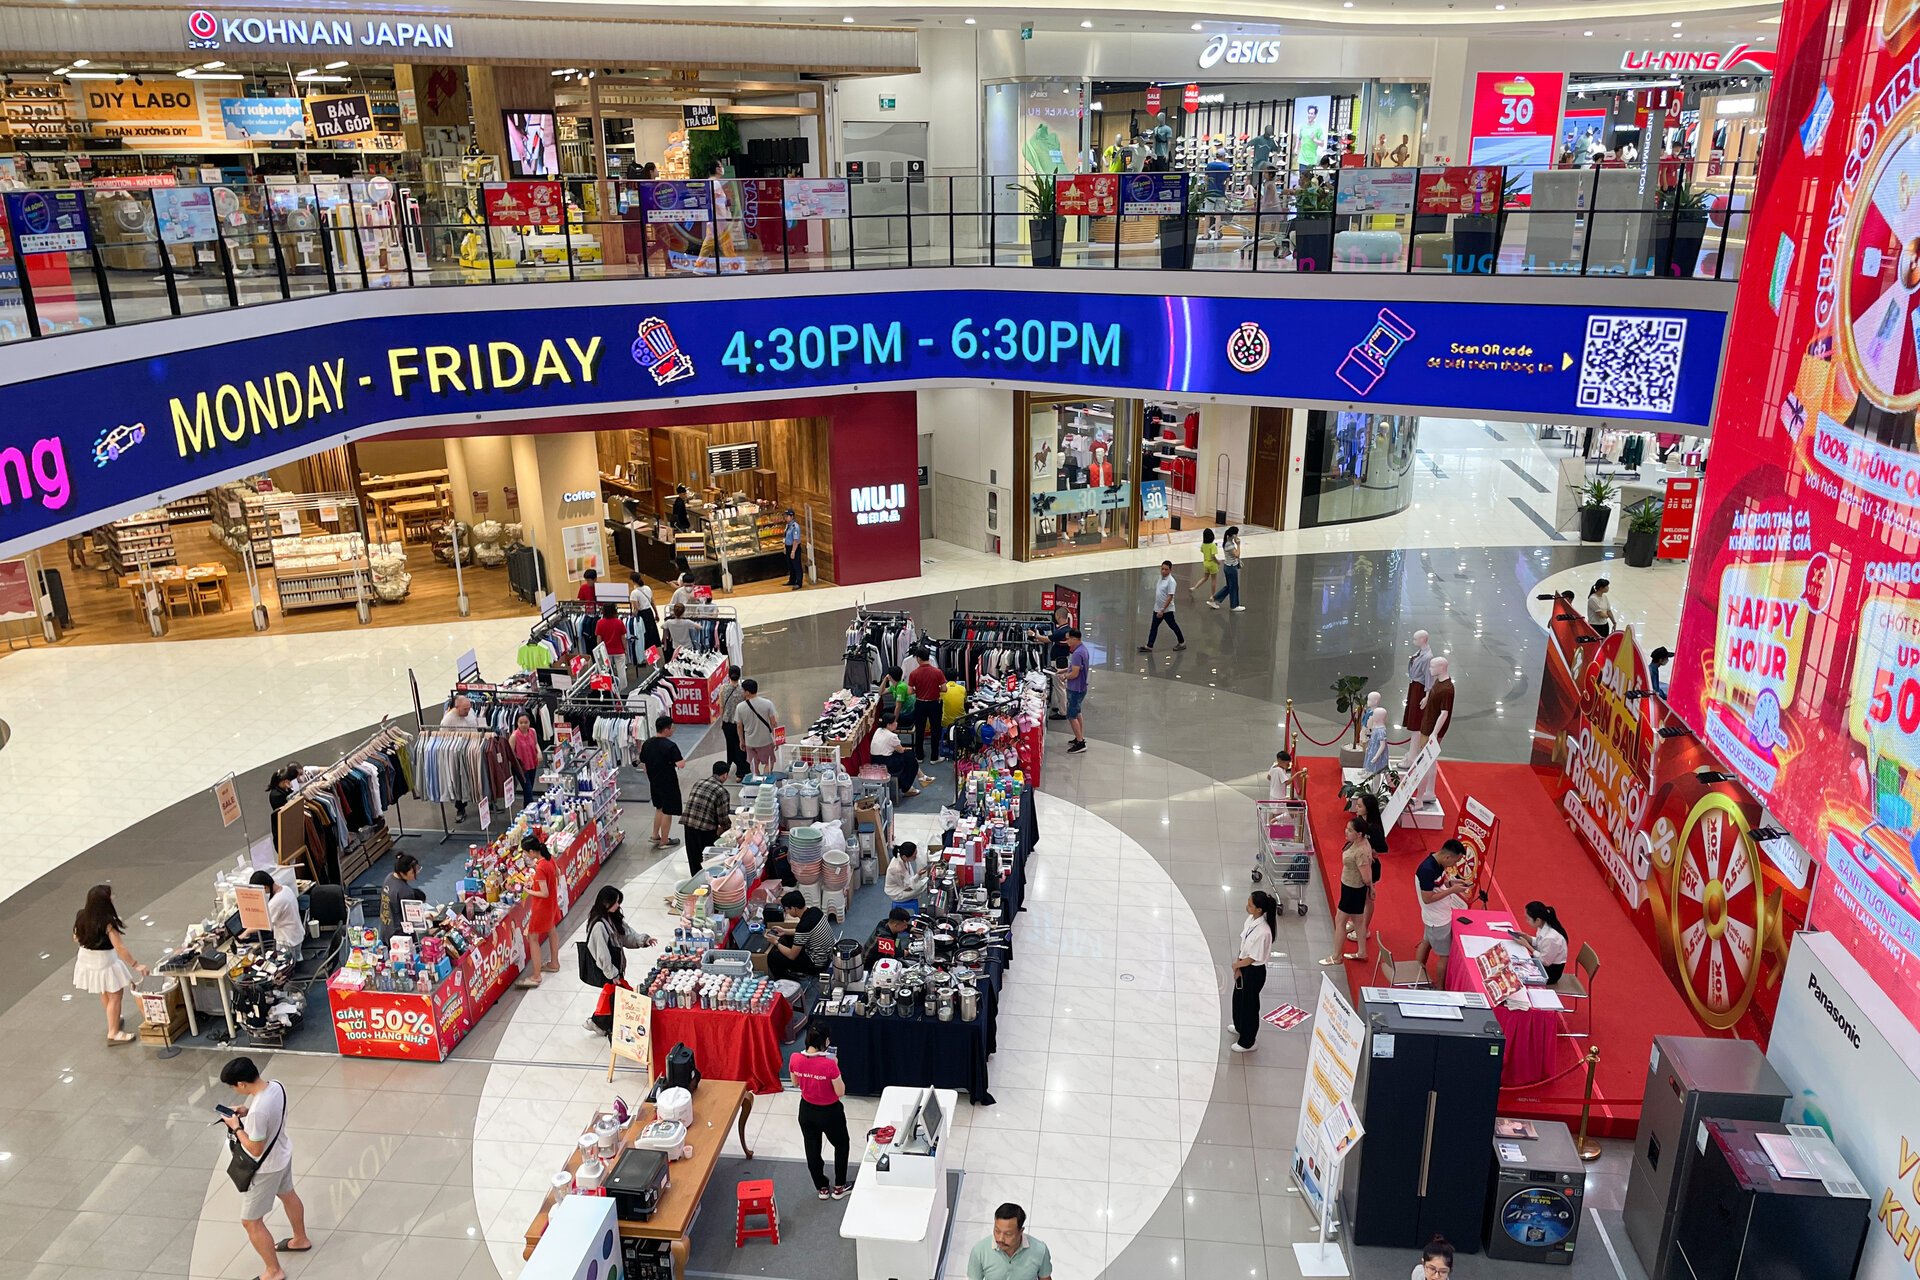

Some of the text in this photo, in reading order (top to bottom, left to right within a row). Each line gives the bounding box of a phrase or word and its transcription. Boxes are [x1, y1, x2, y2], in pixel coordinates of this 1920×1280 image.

[222, 18, 454, 48] KOHNAN JAPAN
[188, 40, 219, 49] コーナン
[1621, 51, 1722, 71] LI-NING
[90, 92, 191, 109] DIY LABO
[1185, 90, 1198, 98] SALE
[224, 103, 248, 116] TIẾT
[327, 101, 355, 118] BÁN
[692, 106, 708, 115] BÁN
[172, 128, 187, 136] DIY
[317, 117, 371, 136] TRẢ GÓP
[1639, 112, 1655, 195] INFORMATION
[94, 180, 131, 189] PROMOTION
[721, 317, 1121, 374] 4:30PM - 6:30PM
[1450, 343, 1534, 357] Scan QR code
[169, 335, 602, 458] MONDAY - FRIDAY
[1817, 430, 1902, 489] 100% TRÚNG
[563, 490, 597, 503] Coffee
[851, 483, 905, 513] MUJI
[1146, 491, 1163, 510] 30
[1865, 560, 1920, 585] COMBO
[1727, 593, 1799, 638] HAPPY
[1727, 635, 1787, 682] HOUR
[675, 703, 700, 716] SALE
[1579, 727, 1619, 790] QUAY
[1725, 739, 1756, 775] VOUCHER
[1755, 765, 1771, 787] 30K
[222, 797, 235, 811] SALE
[1565, 735, 1652, 882] TRÚNG VÀNG
[1710, 817, 1718, 862] 20K
[1681, 869, 1698, 897] 30K
[1725, 867, 1737, 893] 0.5
[483, 939, 511, 979] 50%
[336, 1007, 364, 1020] GIẢM
[370, 1008, 434, 1036] 50%
[1808, 972, 1861, 1050] Panasonic
[349, 1018, 367, 1030] TỚI
[346, 1030, 430, 1046] 1000+ HÀNG NHẬT
